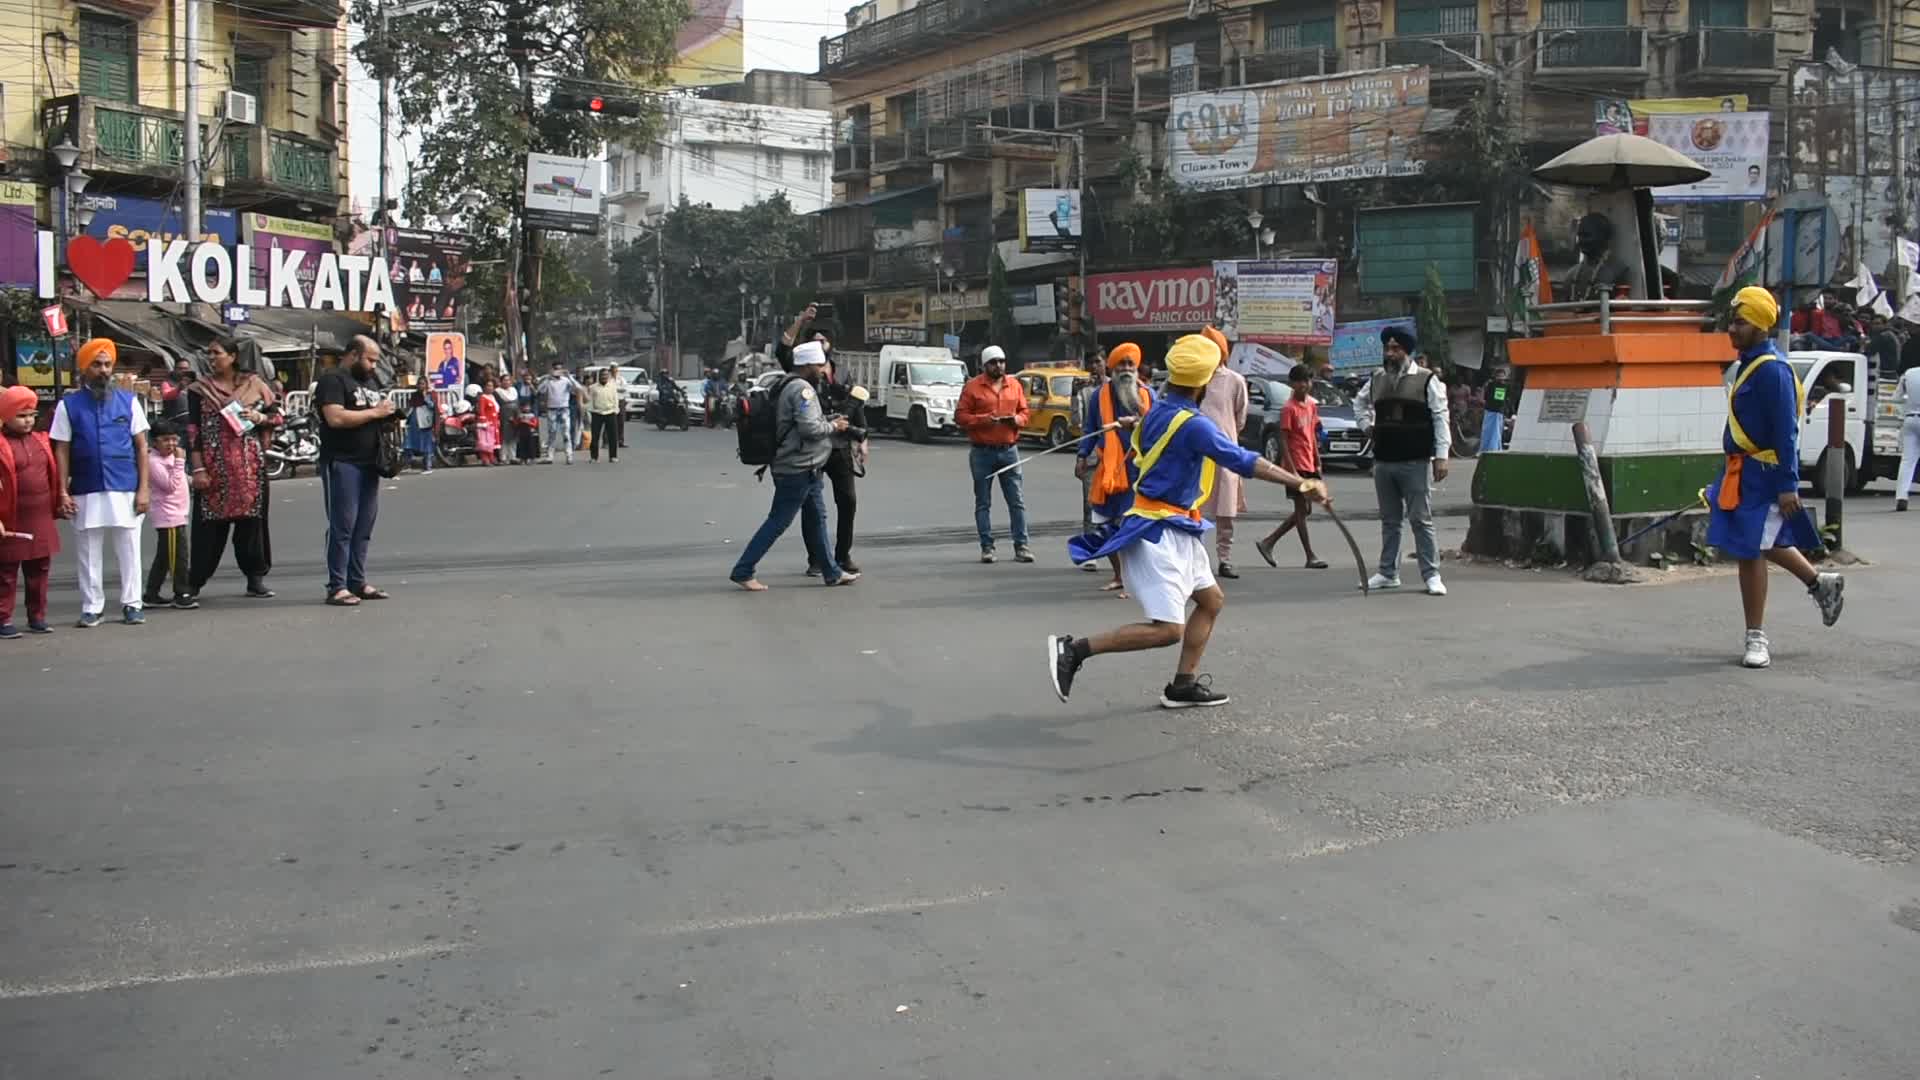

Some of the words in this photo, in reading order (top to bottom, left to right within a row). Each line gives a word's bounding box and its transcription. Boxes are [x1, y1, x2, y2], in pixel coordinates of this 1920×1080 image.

[38, 231, 55, 299] I
[148, 238, 396, 312] KOLKATA
[1097, 276, 1214, 319] Raymo
[1150, 311, 1182, 323] FANCY
